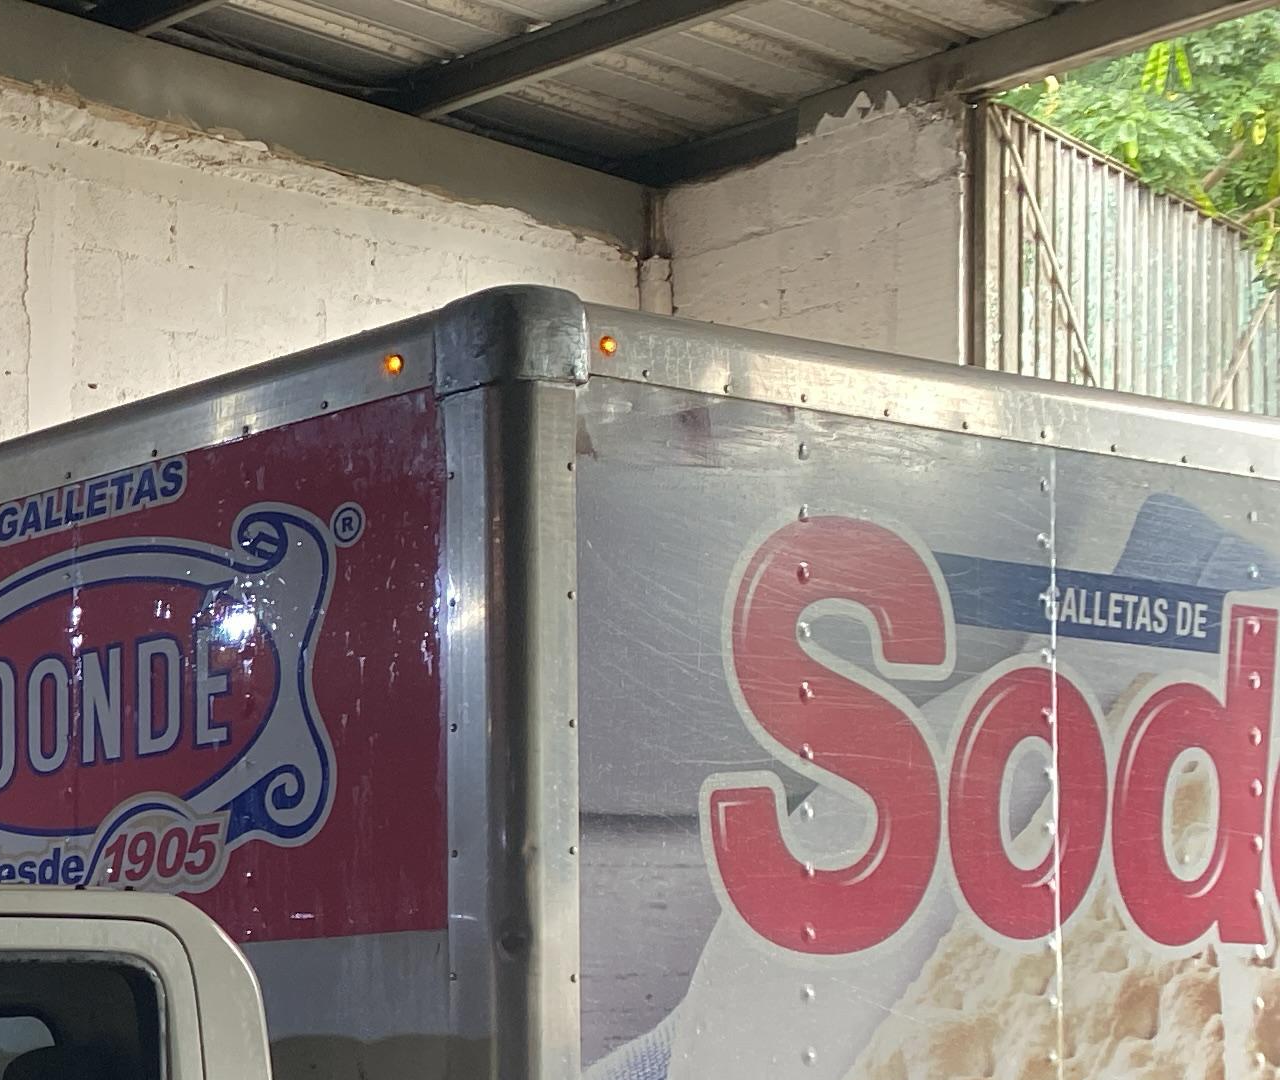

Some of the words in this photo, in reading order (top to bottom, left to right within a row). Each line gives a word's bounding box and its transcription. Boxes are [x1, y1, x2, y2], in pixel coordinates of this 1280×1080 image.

[1044, 584, 1169, 635] GALLETAS
[1176, 600, 1209, 639] DE
[708, 515, 1280, 957] Sod
[104, 822, 221, 883] 1905
